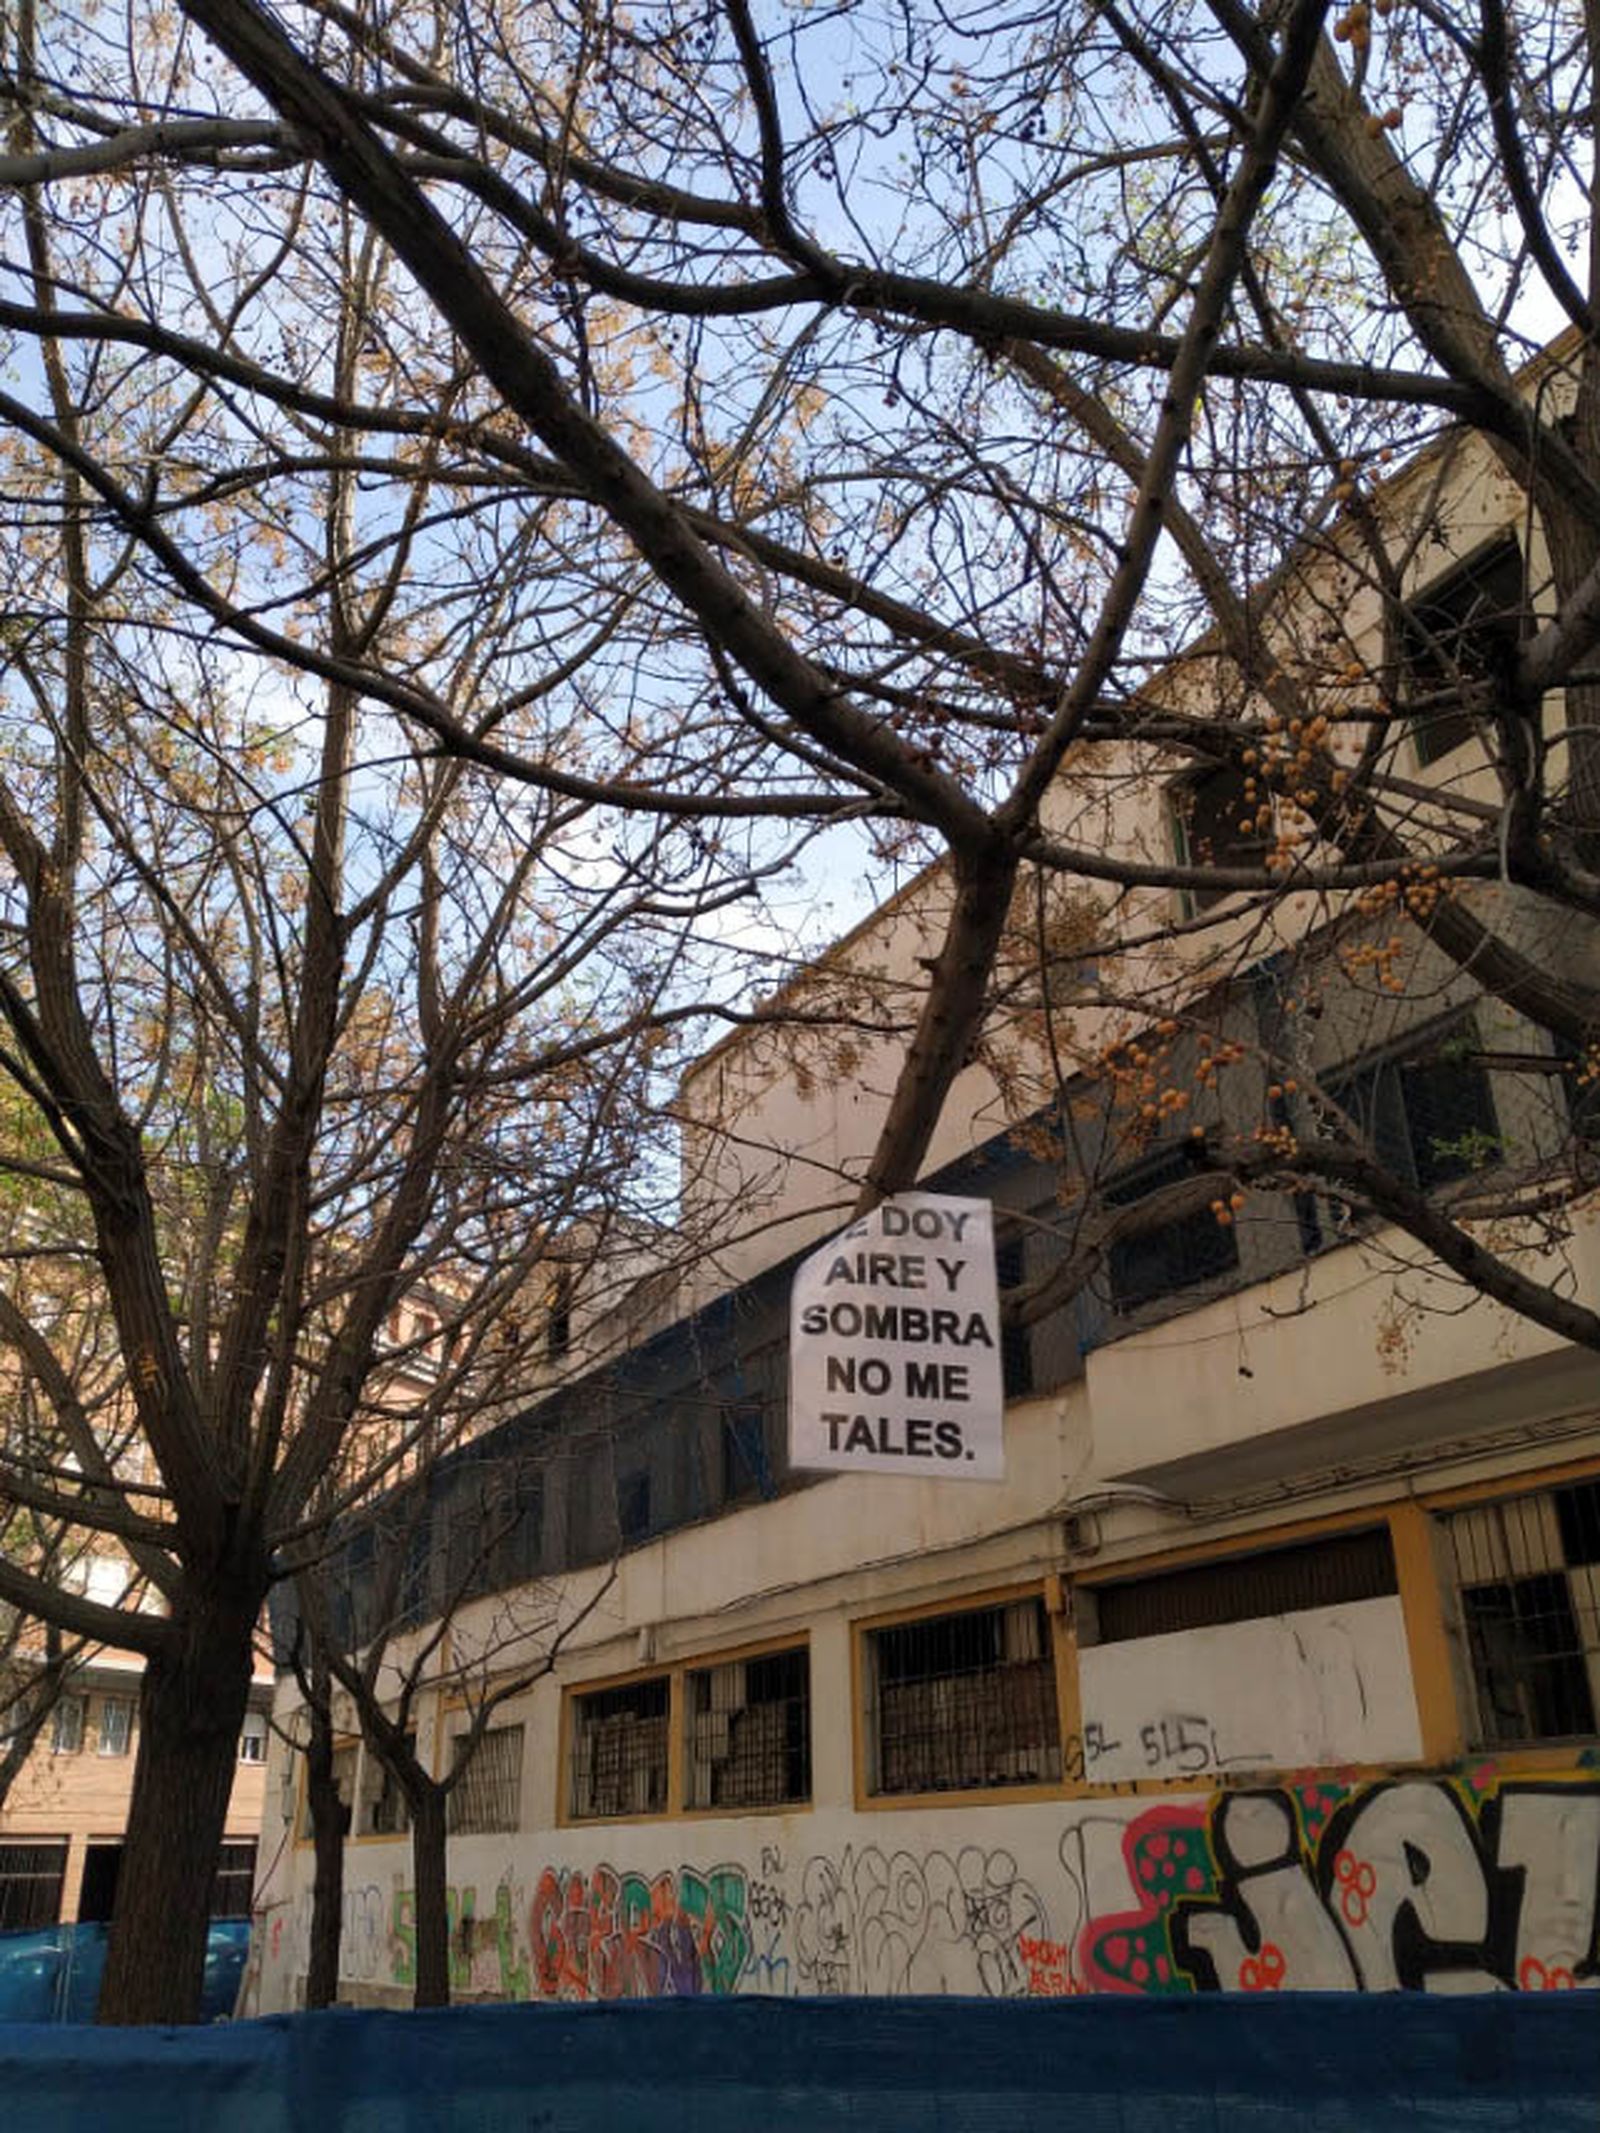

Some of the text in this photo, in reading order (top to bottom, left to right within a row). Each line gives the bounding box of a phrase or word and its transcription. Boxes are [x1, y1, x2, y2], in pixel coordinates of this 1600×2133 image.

[881, 1205, 970, 1243] DOY
[824, 1252, 966, 1292] AIRE Y
[801, 1302, 994, 1348] SOMBRA
[826, 1355, 970, 1401] NO ME
[820, 1412, 975, 1461] TALES.
